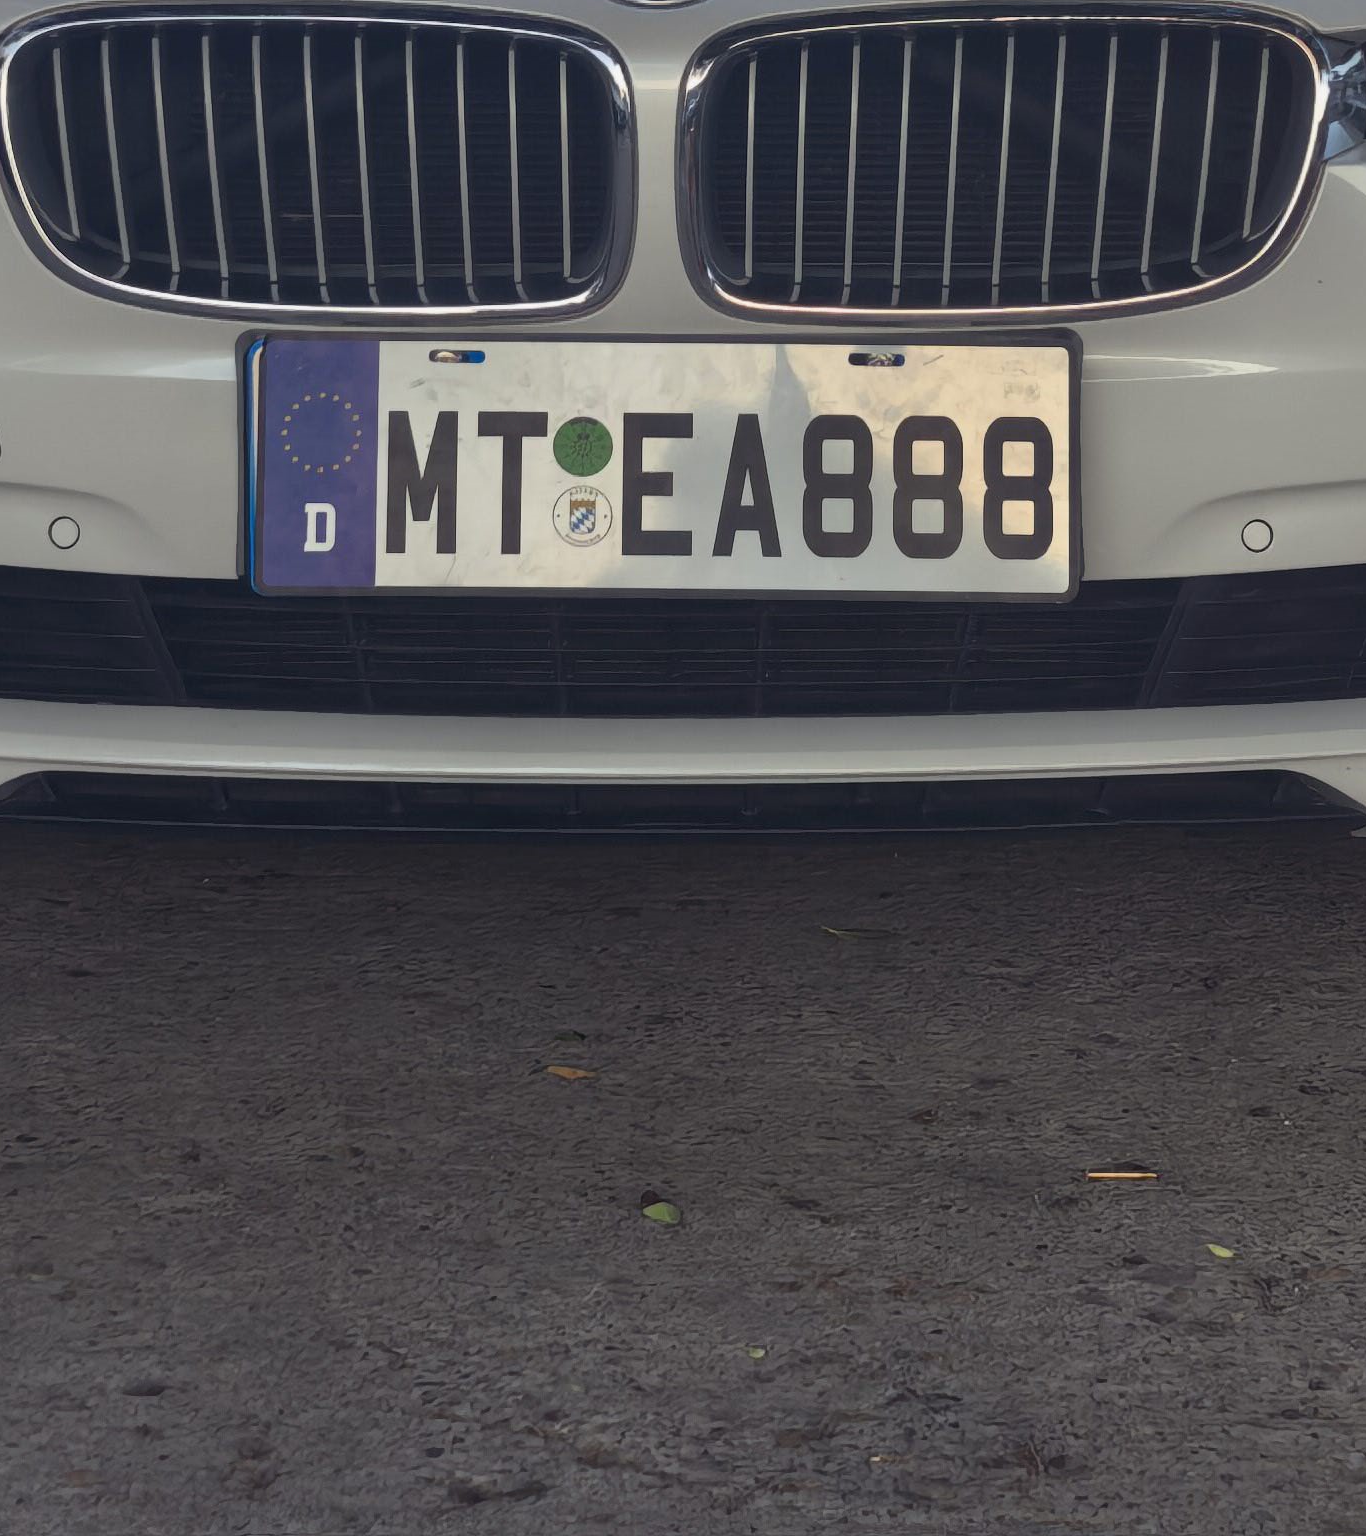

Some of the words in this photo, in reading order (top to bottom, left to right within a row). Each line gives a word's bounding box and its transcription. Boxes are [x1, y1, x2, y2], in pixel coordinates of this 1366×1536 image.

[304, 502, 337, 553] D
[386, 411, 548, 555] MT
[622, 412, 1053, 559] EA888
